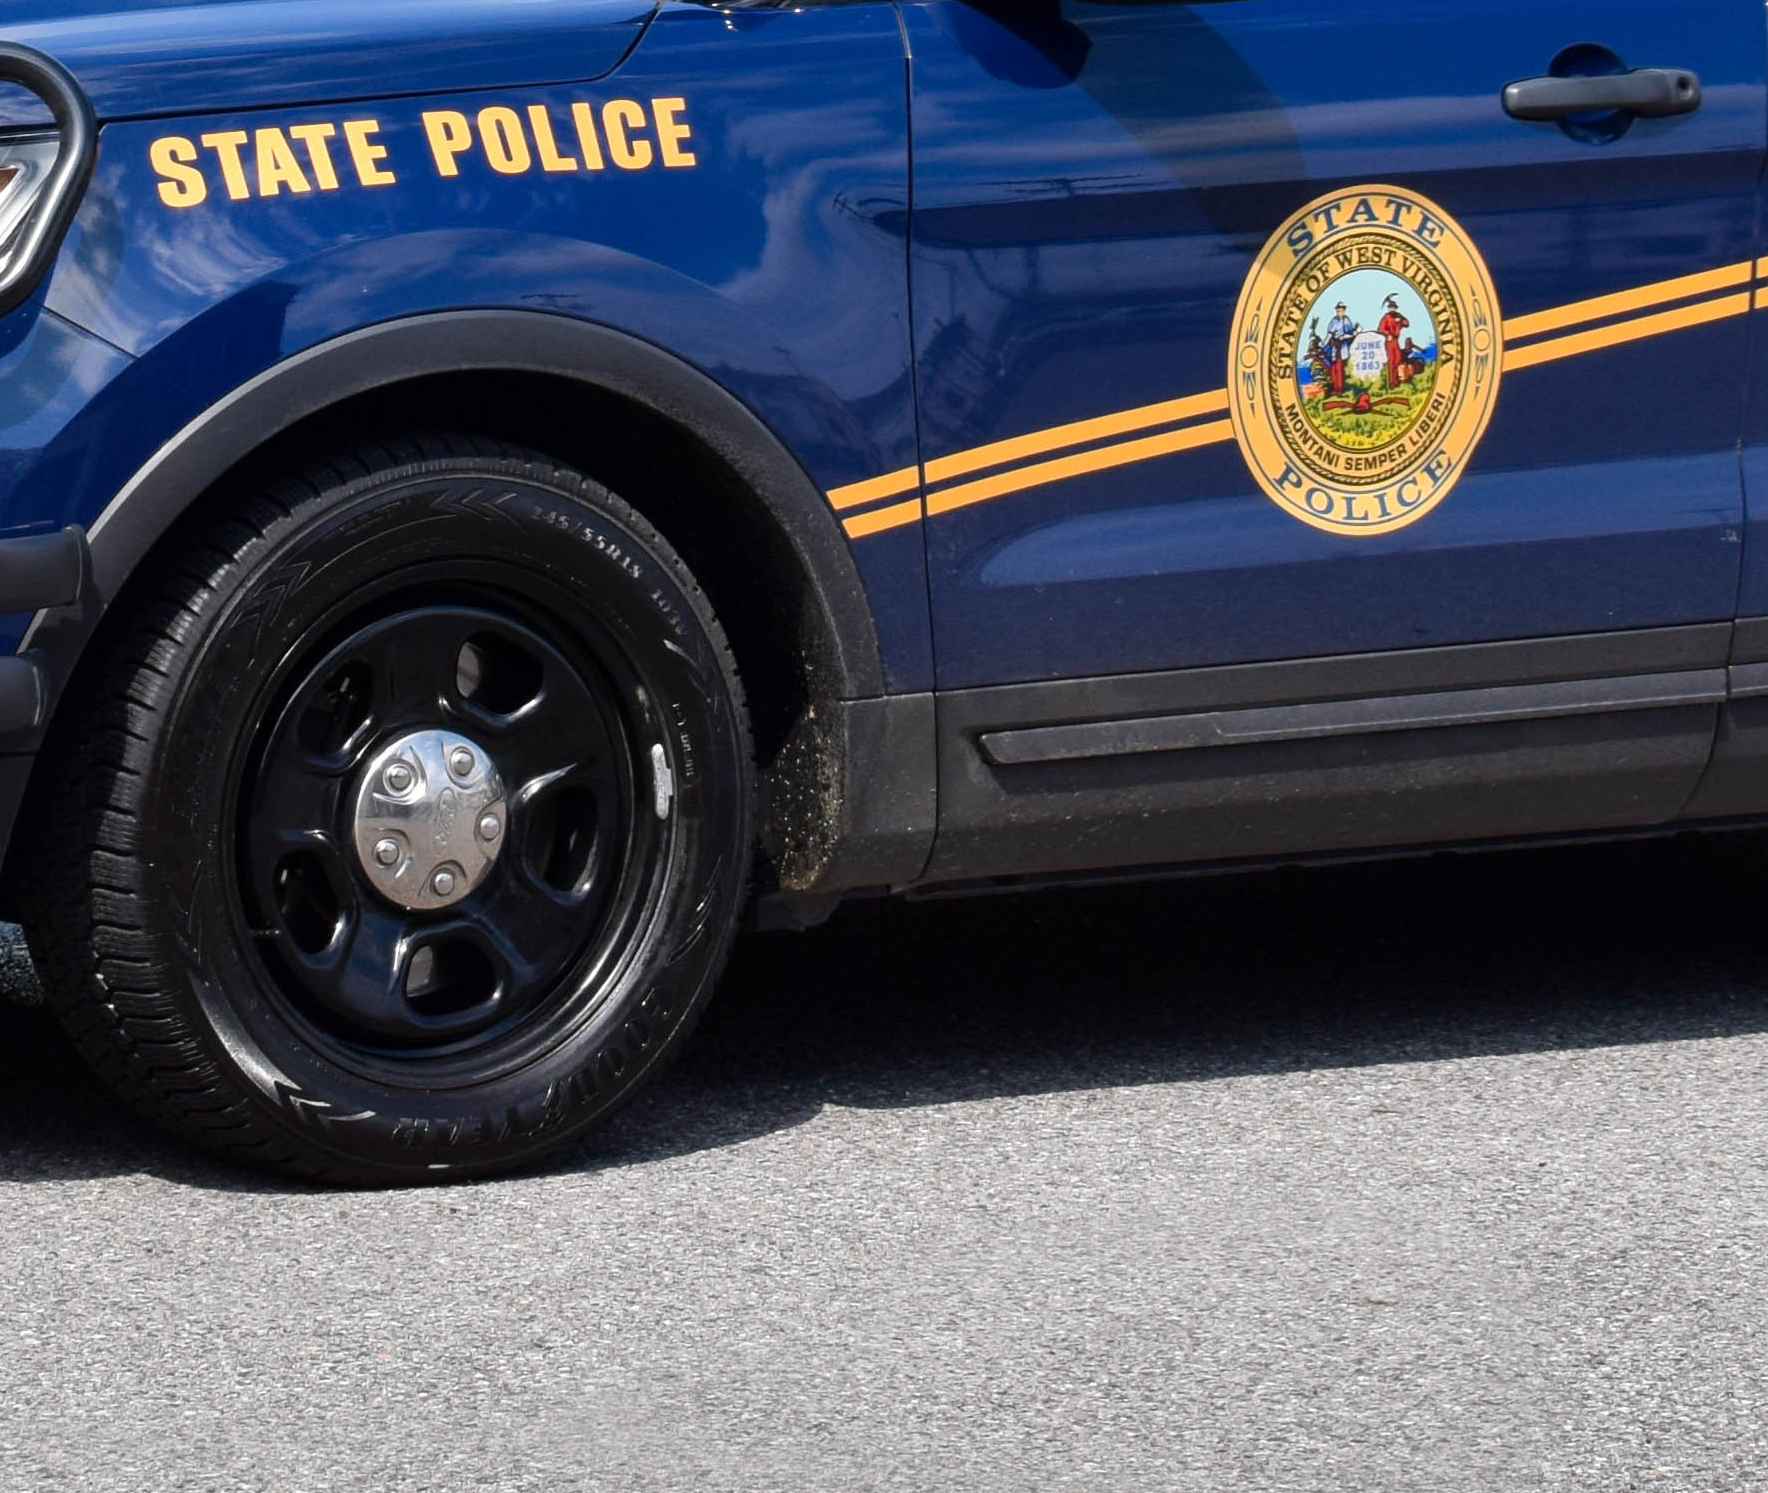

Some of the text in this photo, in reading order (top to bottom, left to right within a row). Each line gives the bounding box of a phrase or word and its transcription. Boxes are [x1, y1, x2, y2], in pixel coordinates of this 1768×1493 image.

[149, 97, 697, 208] STATE POLICE
[1285, 197, 1446, 257] STATE
[1278, 245, 1454, 380] STATE OF WEST VIRGINIA
[1355, 341, 1382, 350] JUNE
[1355, 361, 1381, 370] 1863
[1362, 351, 1375, 360] 20
[1285, 391, 1446, 471] MONTANI SEMPER LIBERI
[1272, 449, 1453, 521] POLICE
